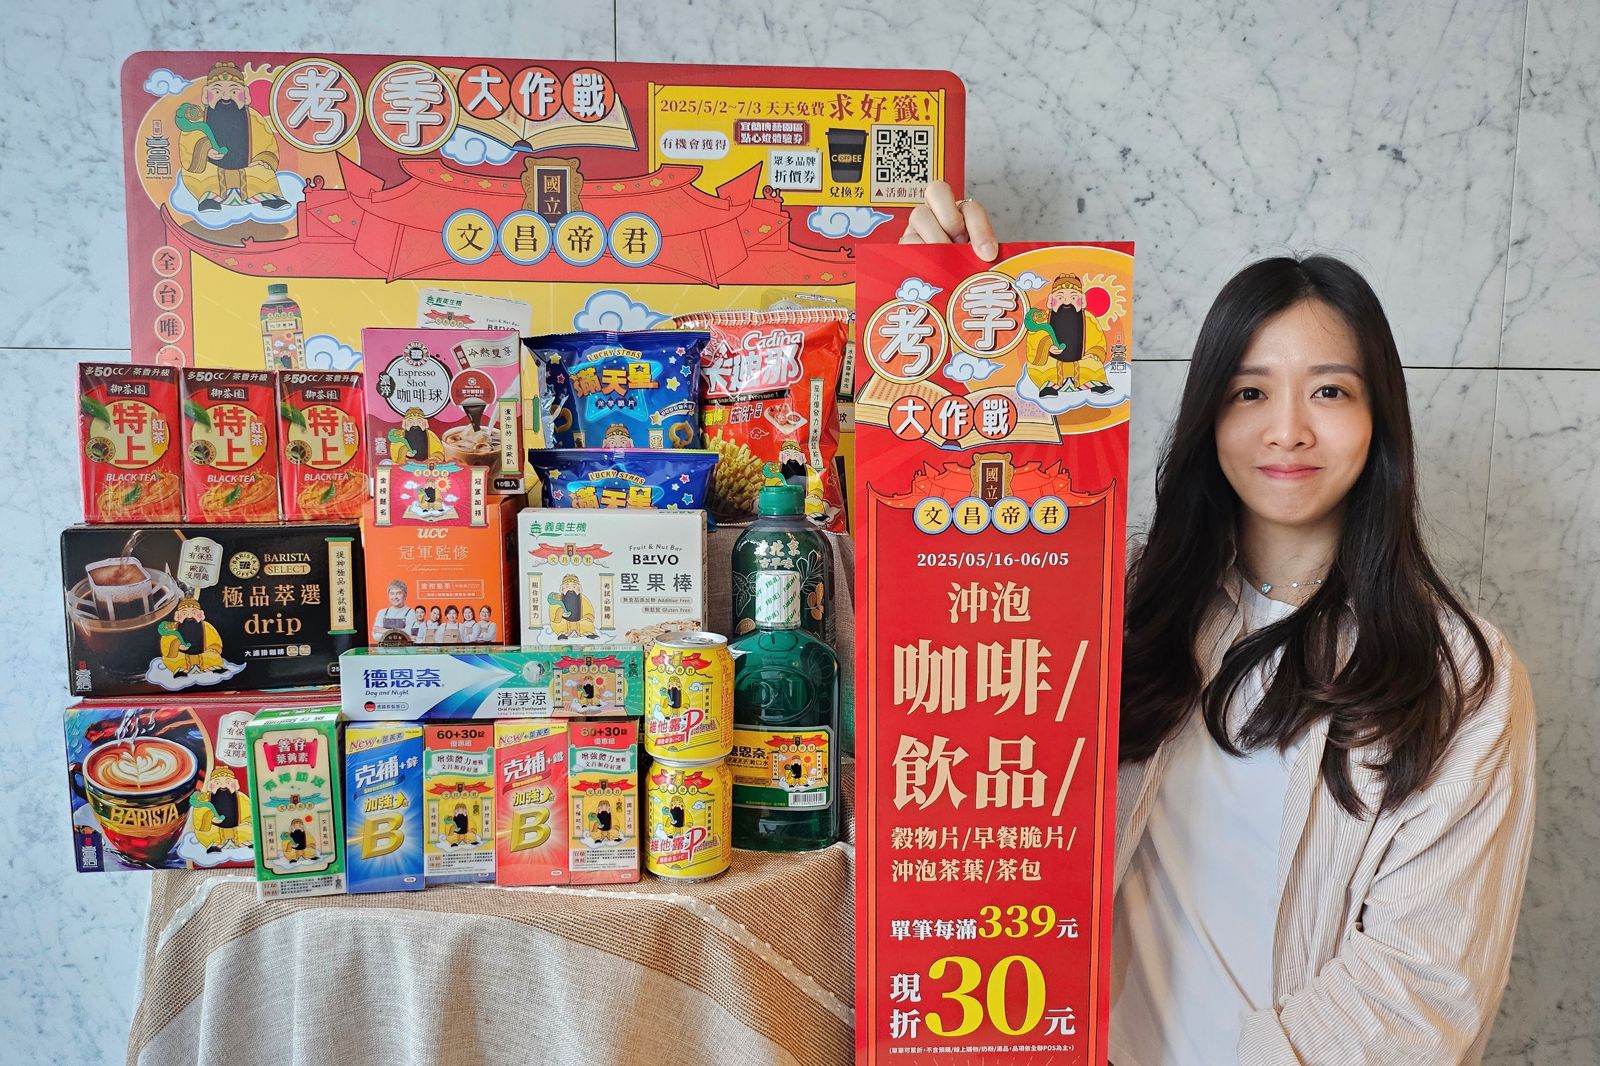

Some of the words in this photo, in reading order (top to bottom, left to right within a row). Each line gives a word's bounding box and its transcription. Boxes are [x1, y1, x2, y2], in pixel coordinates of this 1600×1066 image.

[660, 100, 762, 117] 2025/5/2~7/3
[662, 138, 727, 151] 有機會獲得
[774, 155, 816, 166] 眾多品牌
[774, 170, 816, 184] 折價券
[543, 175, 561, 215] 國立
[456, 223, 648, 255] 文昌帝君
[743, 331, 801, 351] Cadina
[587, 350, 615, 361] LUCKY
[615, 348, 642, 359] STARS
[398, 368, 436, 378] Espresso
[702, 345, 799, 392] 卡迪那
[406, 379, 427, 387] Shot
[570, 362, 659, 398] 滿天星
[110, 384, 147, 395] 御茶園
[210, 388, 246, 399] 御茶園
[305, 389, 339, 400] 御茶園
[396, 389, 442, 403] 咖啡球
[896, 400, 1010, 436] 大作戰
[112, 403, 148, 465] 特上
[152, 418, 165, 444] 紅茶
[213, 406, 248, 467] 特上
[250, 422, 263, 446] 紅茶
[308, 407, 342, 466] 特上
[343, 421, 355, 445] 紅茶
[105, 472, 137, 482] BLACK
[138, 472, 157, 482] TEA
[207, 474, 238, 484] BLACK
[239, 474, 256, 483] TEA
[304, 472, 332, 482] BLACK
[332, 472, 349, 481] TEA
[496, 480, 517, 488] 10個入
[588, 470, 617, 481] LUCKY
[617, 471, 646, 485] STARS
[985, 466, 999, 500] 國立
[924, 506, 1059, 526] 文昌帝君
[544, 522, 587, 532] 義美生機
[399, 545, 469, 561] 冠軍監修
[629, 544, 646, 552] Fruit
[264, 553, 311, 563] BARISTA
[917, 552, 1069, 568] 2025/05/16-06/05
[267, 564, 308, 575] SELECT
[620, 573, 693, 592] 堅果棒
[222, 584, 321, 608] 極品萃選
[947, 581, 1032, 624] 沖泡
[244, 613, 303, 636] drip
[363, 669, 442, 688] 德恩奈
[365, 690, 378, 698] Day
[391, 689, 409, 697] Night
[349, 736, 377, 752] New
[498, 732, 524, 747] New
[364, 794, 394, 813] 加強
[512, 789, 541, 807] 加強
[109, 802, 180, 829] BARISTA
[361, 812, 404, 860] B
[510, 806, 552, 853] B
[891, 858, 1042, 884] 沖泡茶葉/茶包
